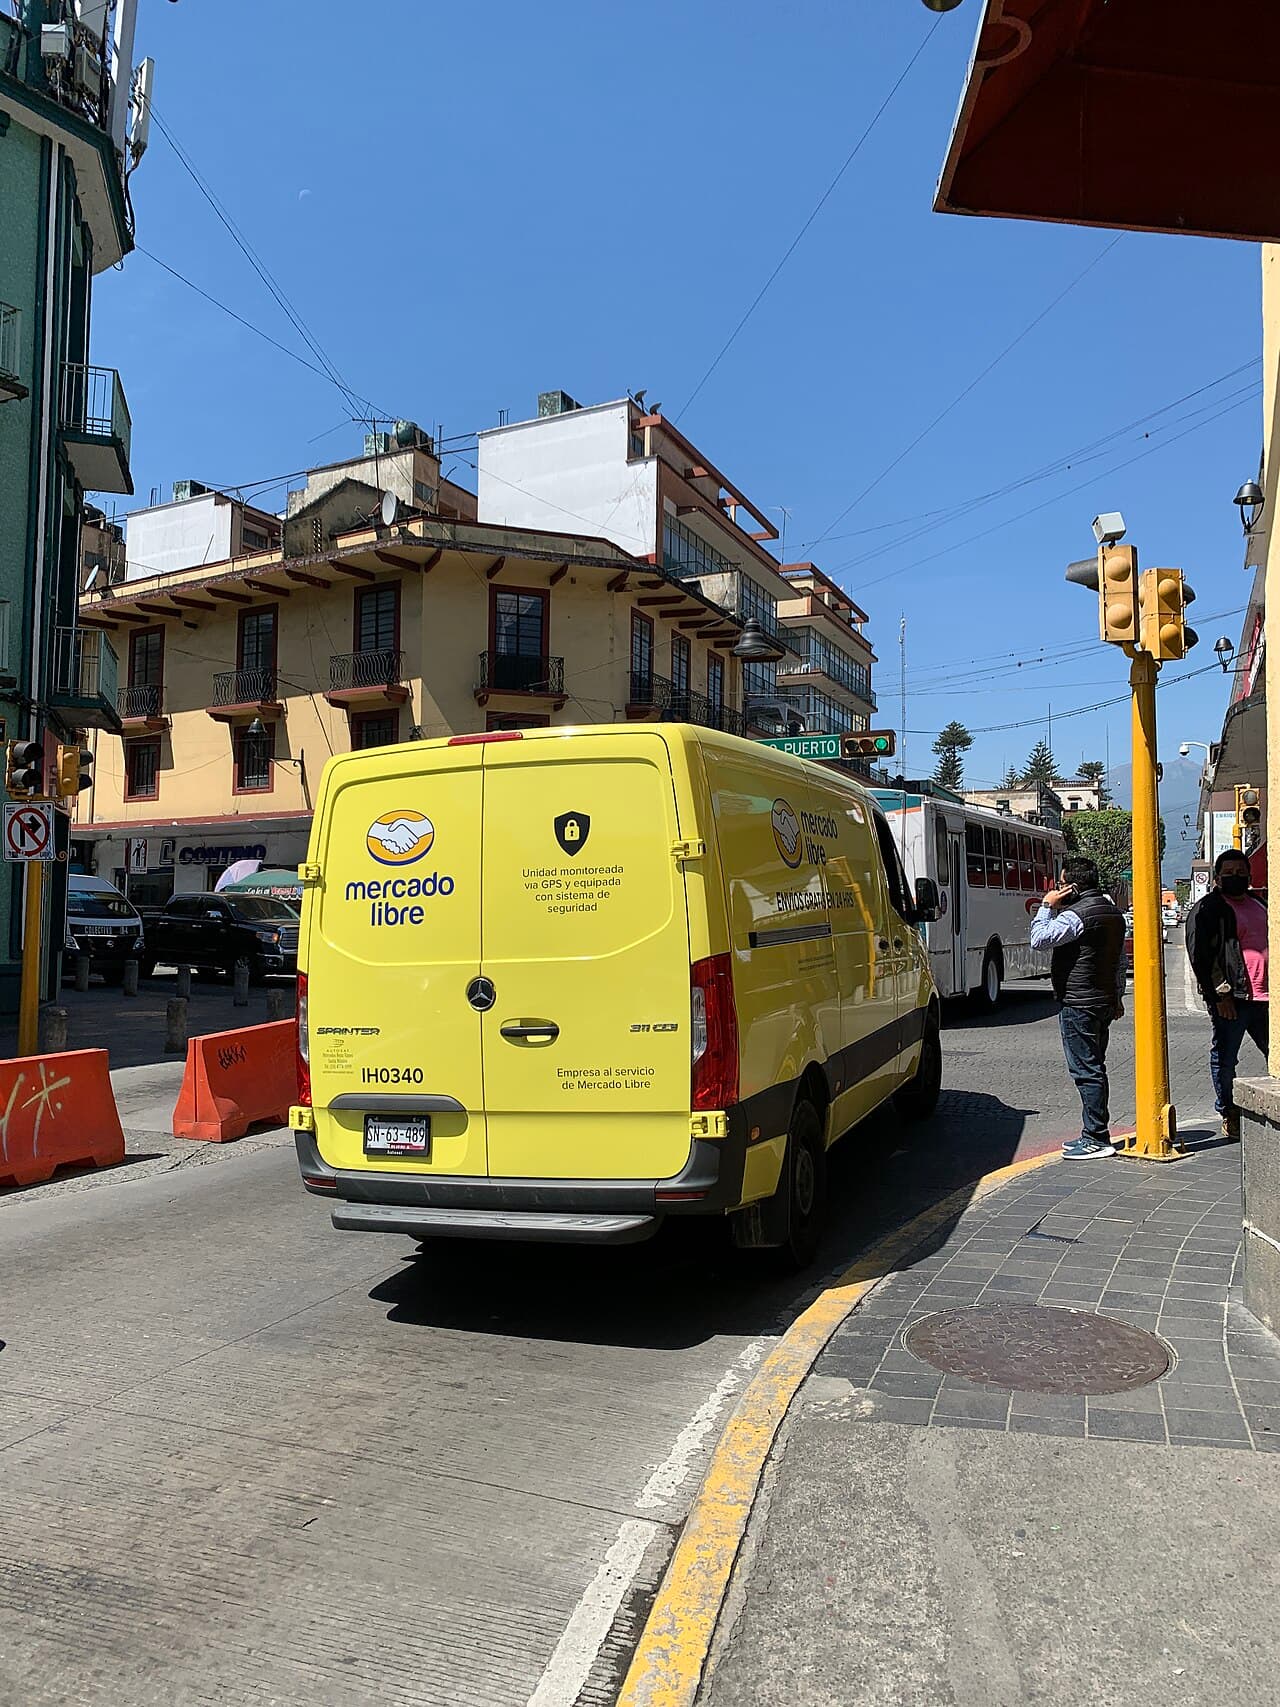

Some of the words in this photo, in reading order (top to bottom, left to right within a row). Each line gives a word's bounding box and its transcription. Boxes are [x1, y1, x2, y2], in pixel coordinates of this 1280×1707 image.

[784, 740, 836, 756] PUERTO
[800, 810, 838, 839] mercado
[804, 835, 826, 866] libre
[522, 867, 557, 877] Unidad
[560, 864, 624, 876] monitoreada
[345, 871, 455, 901] mercado
[541, 879, 562, 889] GPS
[564, 880, 571, 890] y
[573, 877, 621, 889] equipada
[535, 893, 553, 901] con
[555, 891, 594, 901] sistema
[596, 889, 610, 899] de
[371, 901, 425, 926] libre
[547, 903, 598, 915] seguridad
[316, 1027, 381, 1036] SPRINTER
[361, 1067, 424, 1084] IH0340
[556, 1068, 600, 1079] Empresa
[603, 1067, 612, 1076] al
[615, 1066, 655, 1076] servicio
[561, 1080, 575, 1090] de
[577, 1080, 621, 1090] Mercado
[624, 1079, 651, 1089] Libre
[367, 1124, 425, 1143] SN-63-489
